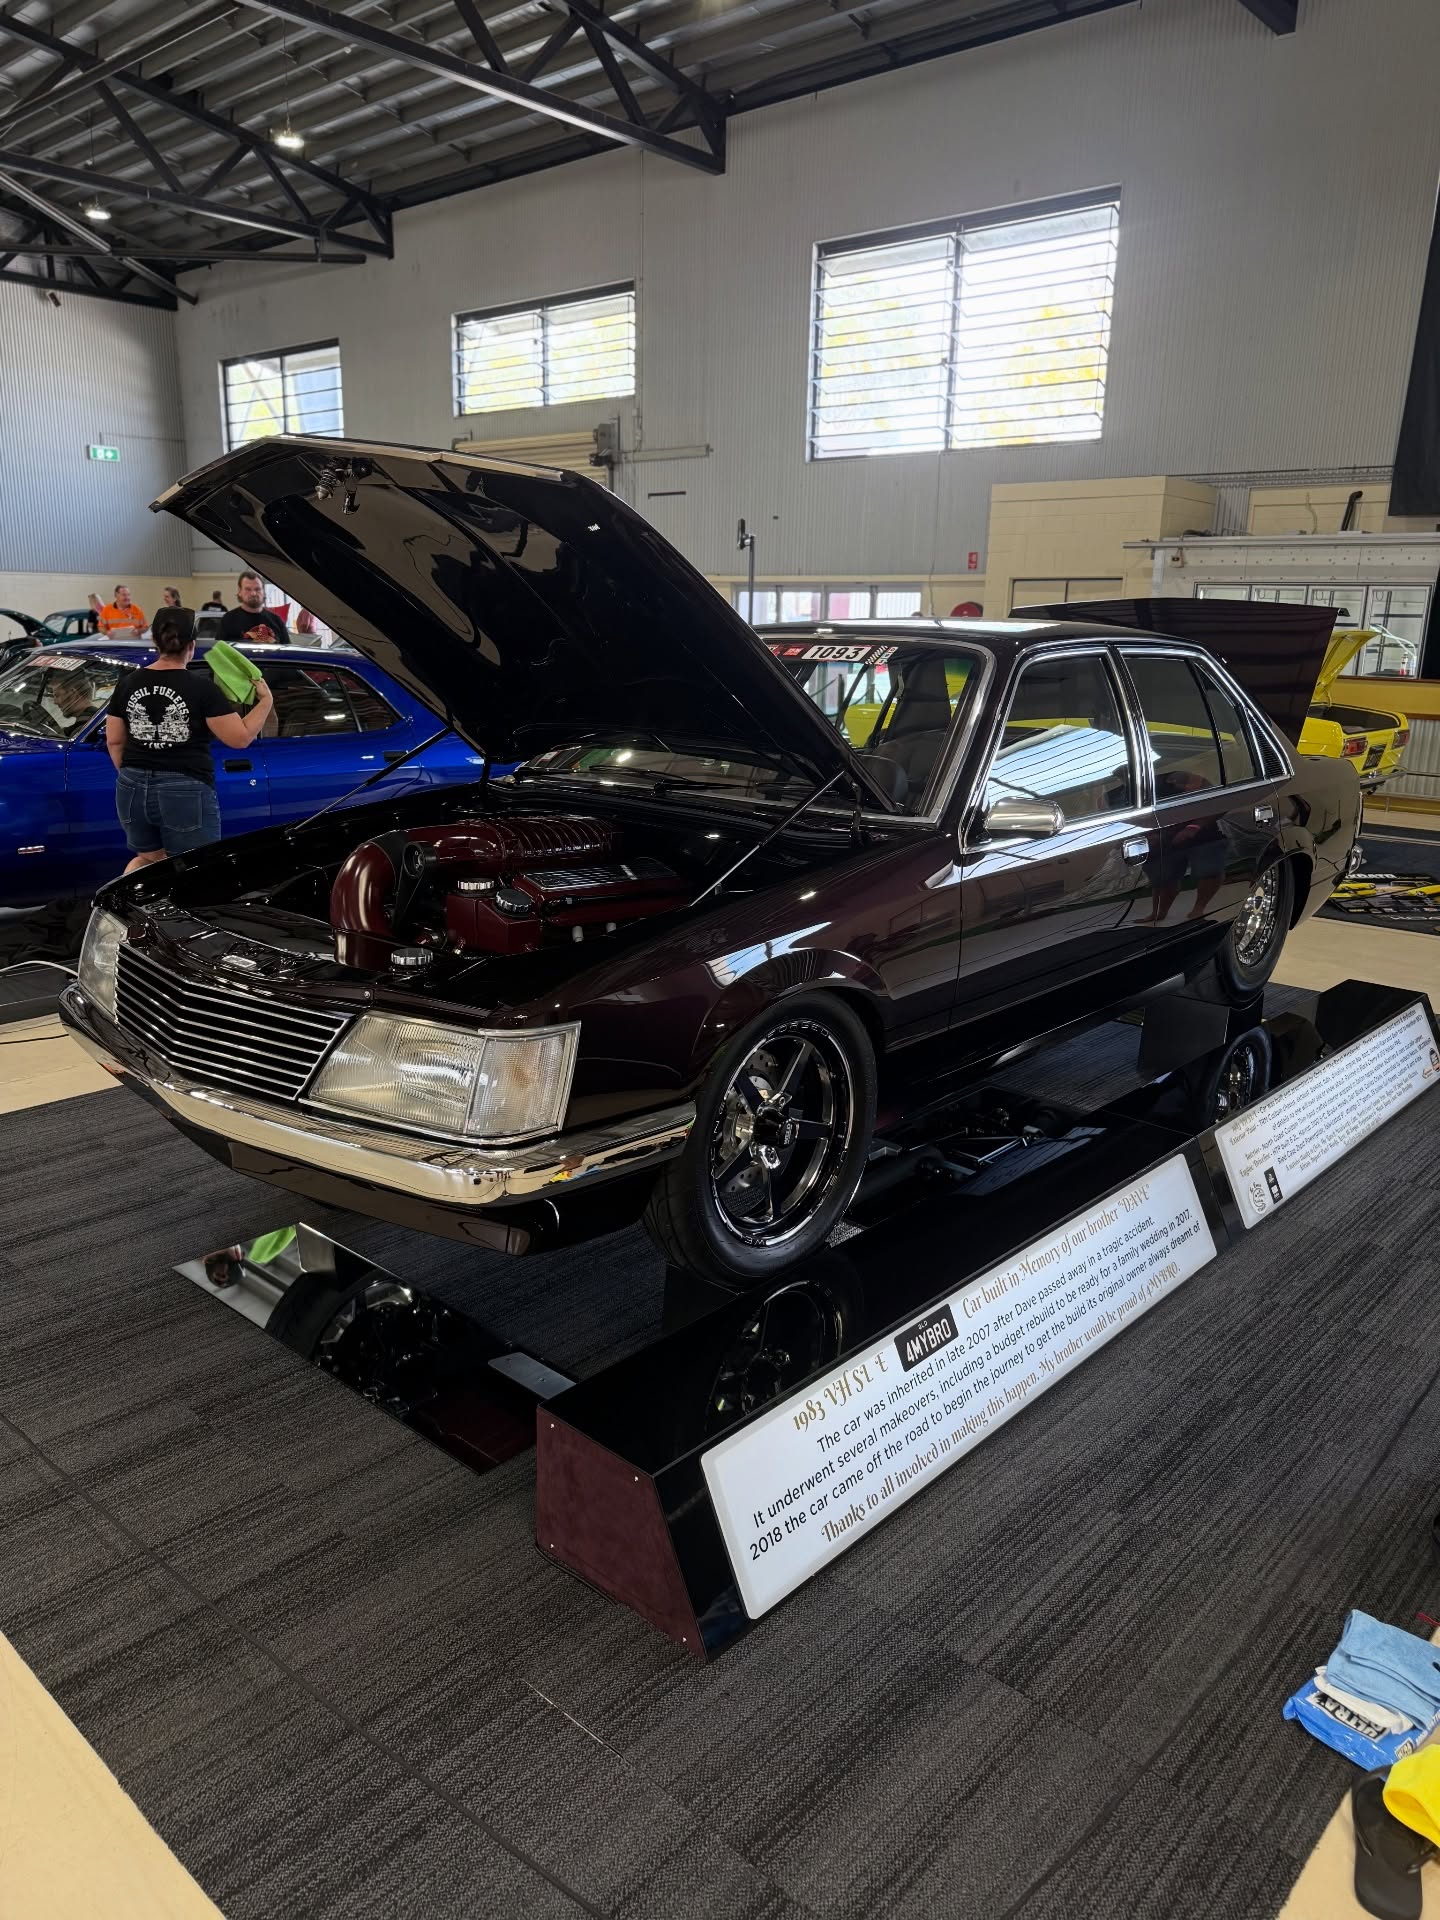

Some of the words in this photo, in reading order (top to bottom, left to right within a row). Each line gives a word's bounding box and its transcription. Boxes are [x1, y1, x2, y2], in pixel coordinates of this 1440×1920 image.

[810, 646, 864, 660] 1093
[126, 687, 151, 712] FOSSIL
[153, 686, 189, 714] FUELERS
[962, 1296, 983, 1319] Car
[981, 1280, 1008, 1305] built
[1007, 1273, 1020, 1292] in
[1019, 1247, 1061, 1281] Memory
[1062, 1238, 1073, 1257] of
[1072, 1231, 1088, 1249] our
[1087, 1208, 1120, 1236] brother
[753, 1510, 766, 1529] It
[767, 1459, 836, 1519] underwent
[837, 1427, 879, 1468] several
[879, 1389, 940, 1438] makeovers,
[938, 1355, 985, 1394] including
[984, 1350, 993, 1361] a
[991, 1324, 1026, 1356] budget
[1025, 1301, 1056, 1333] rebuild
[1054, 1298, 1066, 1311] to
[1064, 1289, 1078, 1304] be
[1077, 1273, 1100, 1296] ready
[1099, 1265, 1112, 1280] for
[1111, 1261, 1119, 1272] a
[1117, 1245, 1140, 1268] family
[1139, 1226, 1169, 1252] wedding
[1167, 1221, 1177, 1233] in
[1174, 1208, 1193, 1227] 2017.
[816, 1430, 842, 1453] The
[843, 1415, 861, 1436] car
[863, 1399, 887, 1422] was
[886, 1361, 935, 1406] inherited
[933, 1357, 947, 1372] in
[945, 1344, 966, 1365] late
[965, 1323, 990, 1351] 2007
[992, 1309, 1014, 1332] after
[1014, 1295, 1038, 1317] Dave
[1037, 1272, 1067, 1304] passed
[1066, 1260, 1088, 1281] away
[1086, 1255, 1097, 1268] in
[1096, 1251, 1103, 1262] a
[1101, 1236, 1124, 1257] tragic
[1123, 1215, 1156, 1243] accident.
[905, 1318, 952, 1363] 4MYBRO
[749, 1521, 783, 1561] 2018
[783, 1511, 807, 1534] the
[809, 1492, 829, 1516] car
[831, 1468, 865, 1500] came
[866, 1450, 883, 1474] off
[881, 1439, 904, 1460] the
[904, 1416, 931, 1446] road
[930, 1410, 943, 1426] to
[942, 1387, 973, 1417] begin
[972, 1376, 990, 1395] the
[988, 1349, 1024, 1385] journey
[1024, 1342, 1036, 1356] to
[1036, 1328, 1053, 1351] get
[1050, 1320, 1067, 1337] the
[1064, 1301, 1087, 1326] build
[1085, 1297, 1098, 1311] its
[1097, 1273, 1126, 1303] original
[1125, 1260, 1148, 1283] owner
[1146, 1244, 1171, 1267] always
[1170, 1226, 1194, 1250] dreamt
[1192, 1219, 1201, 1234] of
[793, 1399, 826, 1432] 1983
[820, 1501, 866, 1543] Thanks
[865, 1493, 879, 1511] to
[878, 1474, 896, 1500] all
[893, 1442, 939, 1488] involved
[937, 1437, 951, 1454] in
[950, 1407, 989, 1445] making
[986, 1392, 1005, 1417] this
[1002, 1371, 1040, 1404] happen.
[1038, 1353, 1055, 1378] My
[1052, 1335, 1084, 1365] brother
[1083, 1314, 1108, 1342] would
[1104, 1309, 1118, 1325] be
[1116, 1291, 1138, 1323] proud
[1137, 1283, 1147, 1304] of
[1324, 1697, 1379, 1740] ULTRA
